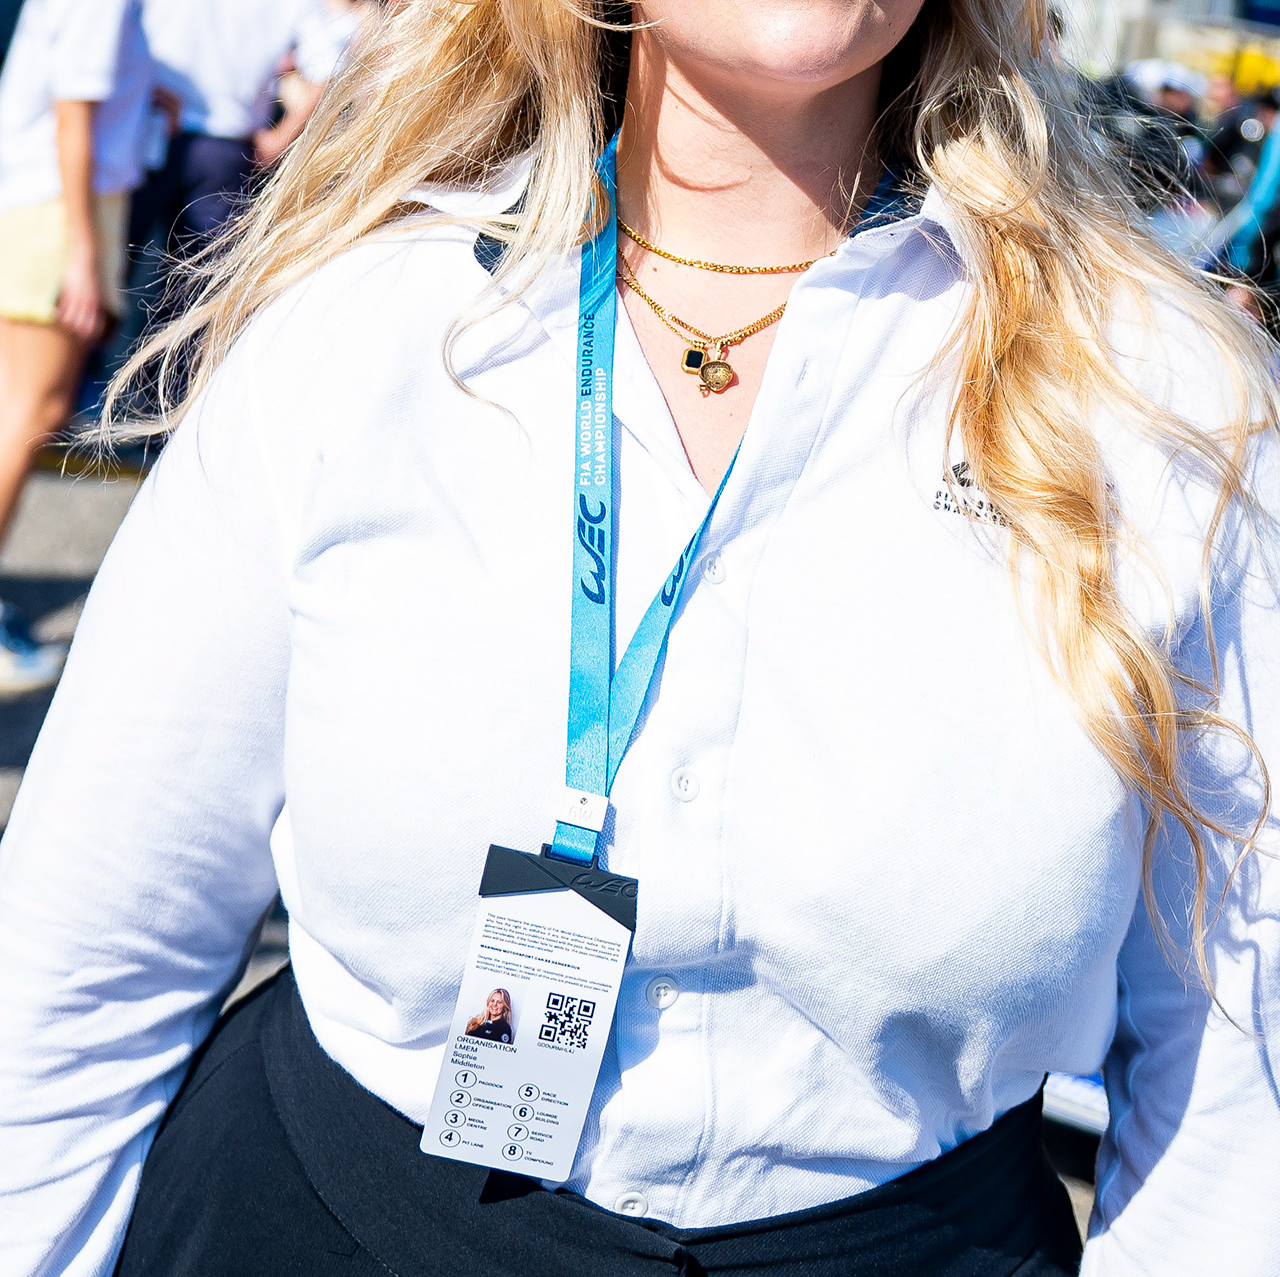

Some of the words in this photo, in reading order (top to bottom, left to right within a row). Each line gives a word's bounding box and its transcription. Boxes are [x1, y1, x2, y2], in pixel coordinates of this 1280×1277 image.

[581, 313, 595, 397] ENDURANCE
[580, 400, 593, 457] WORLD
[594, 367, 607, 486] CHAMPIONSHIP
[580, 461, 592, 486] FIA
[577, 493, 607, 605] WEC
[455, 1043, 478, 1053] LMEM
[456, 1035, 517, 1054] ORGANISATION
[453, 1050, 478, 1062] Sophie
[451, 1058, 485, 1071] Middleton
[461, 1072, 468, 1083] 1
[479, 1080, 503, 1089] PADDOCK
[455, 1092, 464, 1104] 2
[524, 1086, 534, 1098] 5
[472, 1103, 494, 1111] OFFICES
[541, 1097, 569, 1106] DIRECTION
[519, 1106, 528, 1118] 6
[537, 1111, 558, 1119] LOUNGE
[450, 1113, 459, 1124] 3
[535, 1117, 559, 1125] BUILDING
[444, 1131, 454, 1142] 4
[513, 1127, 523, 1138] 7
[532, 1131, 553, 1139] SERVICE
[508, 1145, 517, 1156] 8
[524, 1156, 554, 1166] COMPOUND
